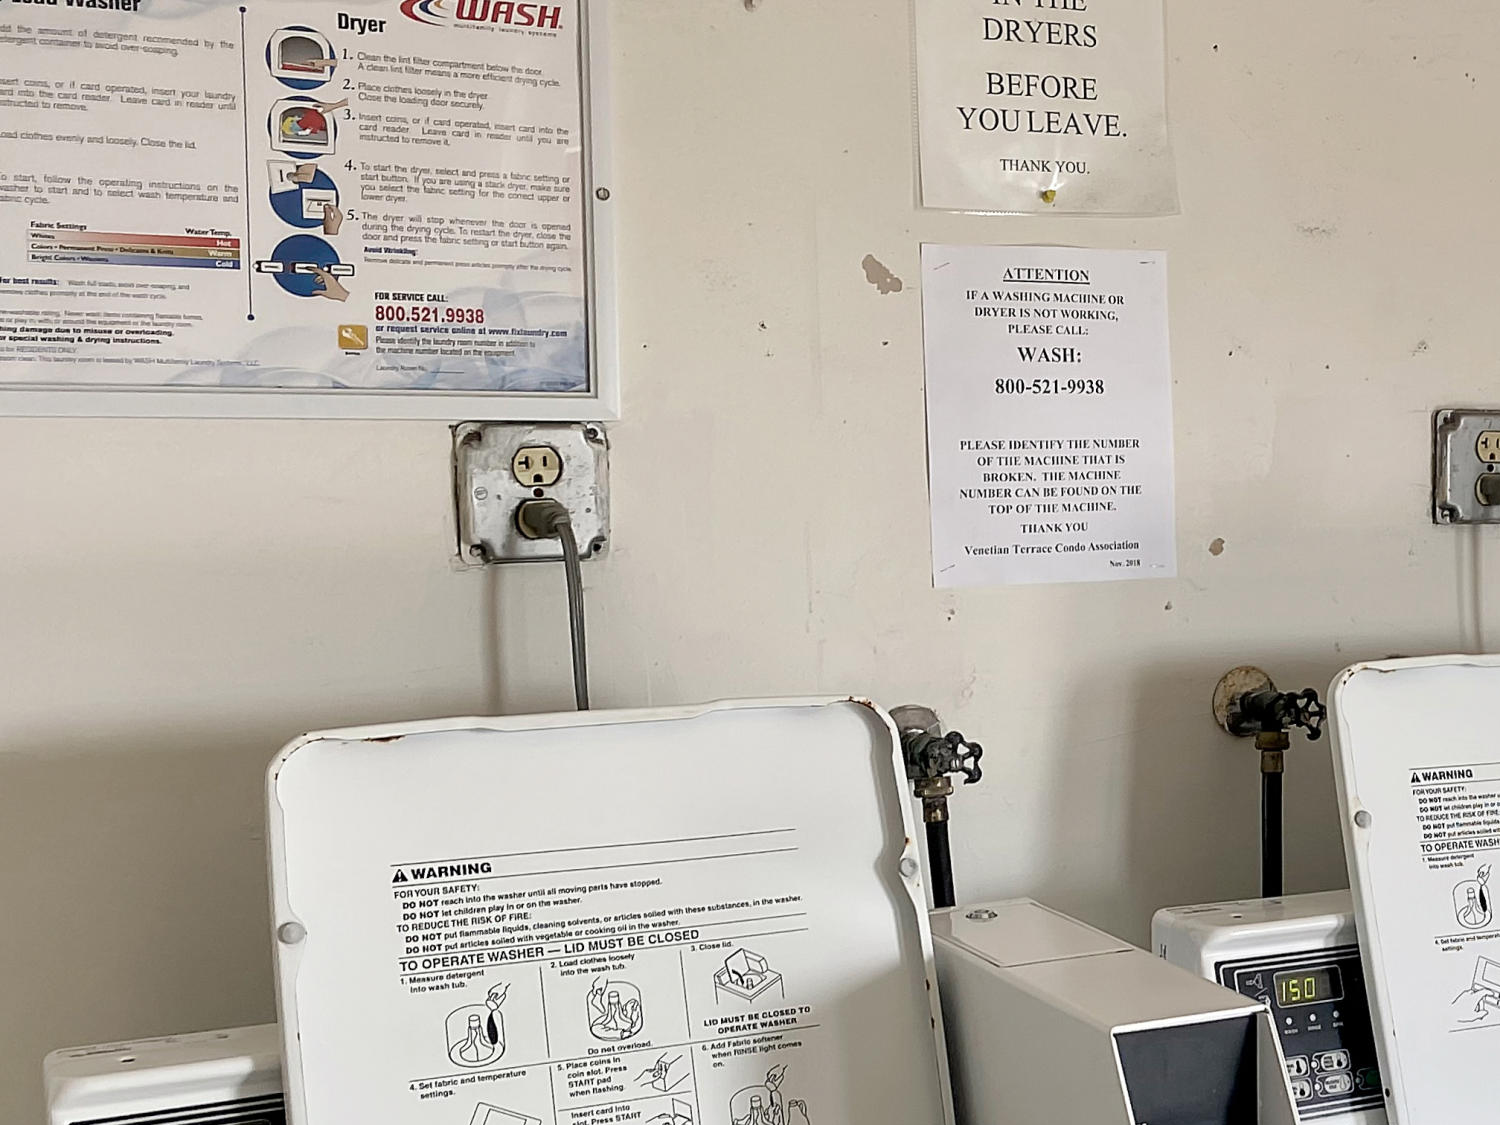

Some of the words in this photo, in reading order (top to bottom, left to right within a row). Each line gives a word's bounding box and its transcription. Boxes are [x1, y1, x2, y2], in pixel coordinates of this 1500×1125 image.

[455, 0, 561, 29] WASH
[337, 12, 387, 34] Dryer
[982, 17, 1097, 48] DRYERS
[342, 79, 355, 91] 2.
[357, 82, 382, 93] Place
[414, 87, 442, 99] loosely
[453, 90, 467, 99] the
[986, 72, 1098, 100] BEFORE
[357, 92, 382, 102] Close
[383, 95, 397, 103] the
[398, 95, 429, 107] loading
[430, 96, 449, 107] door
[956, 107, 1021, 132] YOU
[1026, 110, 1127, 137] LEAVE.
[999, 158, 1052, 172] THANK
[1055, 161, 1090, 175] YOU.
[345, 209, 359, 221] 5.
[361, 211, 378, 221] The
[408, 215, 422, 223] will
[426, 216, 445, 226] stop
[491, 220, 505, 228] the
[508, 221, 527, 229] door
[541, 224, 571, 232] opened
[207, 249, 233, 257] Warm
[215, 260, 233, 268] Cold
[1003, 267, 1089, 281] ATTENTION
[374, 292, 390, 300] FOR
[392, 292, 425, 302] SERVICE
[426, 294, 449, 303] CALL:
[966, 290, 978, 300] IF
[981, 291, 989, 300] A
[992, 291, 1050, 302] WASHING
[1053, 293, 1106, 304] MACHINE
[1108, 295, 1124, 305] OR
[375, 305, 484, 324] 800.521.9938
[975, 307, 1016, 318] DRYER
[1019, 308, 1031, 318] IS
[1033, 308, 1058, 318] NOT
[1060, 309, 1118, 322] WORKING,
[386, 325, 418, 334] request
[420, 326, 449, 334] service
[451, 326, 476, 335] online
[478, 327, 486, 335] at
[1008, 324, 1053, 334] PLEASE
[1055, 325, 1089, 335] CALL:
[1017, 347, 1081, 363] WASH:
[995, 378, 1104, 394] 800-521-9938
[960, 440, 1005, 450] PLEASE
[1009, 440, 1062, 450] IDENTIFY
[1069, 439, 1090, 449] THE
[1093, 439, 1140, 448] NUMBER
[977, 456, 994, 466] OF
[996, 456, 1021, 466] THE
[1024, 455, 1079, 466] MACHINE
[1084, 455, 1112, 465] THAT
[1115, 454, 1125, 464] IS
[983, 472, 1037, 482] BROKEN.
[1043, 472, 1065, 481] THE
[1068, 470, 1121, 481] MACHINE
[960, 488, 1012, 499] NUMBER
[1015, 488, 1040, 498] CAN
[1043, 487, 1058, 497] BE
[1061, 486, 1099, 497] FOUND
[1101, 486, 1117, 495] ON
[1120, 485, 1142, 495] THE
[988, 505, 1013, 514] TOP
[1015, 504, 1032, 514] OF
[1037, 504, 1058, 513] THE
[1062, 501, 1117, 512] MACHINE.
[1020, 523, 1062, 533] THANK
[1065, 522, 1088, 532] YOU
[964, 545, 1009, 555] Venetian
[1014, 544, 1053, 554] Terrace
[1054, 542, 1086, 553] Condo
[1088, 540, 1139, 551] Association
[1126, 559, 1141, 567] 2018
[1421, 769, 1473, 781] WARNING
[1420, 843, 1433, 852] TO
[1434, 840, 1474, 852] OPERATE
[411, 862, 492, 880] WARNING
[394, 890, 414, 899] FOR
[414, 887, 440, 897] YOUR
[402, 901, 417, 910] DO
[419, 899, 439, 908] NOT
[441, 897, 464, 906] reach
[482, 894, 496, 902] the
[497, 892, 526, 900] washer
[527, 889, 546, 897] until
[558, 886, 587, 894] moving
[588, 884, 609, 893] parts
[630, 878, 663, 888] stopped.
[402, 912, 417, 921] DO
[419, 910, 440, 919] NOT
[441, 909, 452, 917] let
[453, 907, 487, 916] children
[488, 905, 505, 914] play
[552, 897, 583, 906] washer.
[396, 924, 410, 933] TO
[411, 920, 450, 931] REDUCE
[450, 918, 469, 927] THE
[471, 916, 493, 925] RISK
[494, 914, 507, 923] OF
[399, 960, 418, 972] TO
[422, 952, 485, 969] OPERATE
[487, 946, 545, 962] WASHER
[564, 942, 585, 954] LID
[588, 937, 624, 951] MUST
[627, 935, 645, 947] BE
[648, 929, 699, 944] CLOSED
[1282, 977, 1315, 1002] 150
[703, 1019, 719, 1027] LID
[720, 1015, 745, 1025] MUST
[747, 1013, 760, 1021] BE
[761, 1008, 797, 1019] CLOSED
[798, 1006, 811, 1014] TO
[717, 1022, 758, 1034] OPERATE
[759, 1017, 797, 1029] WASHER
